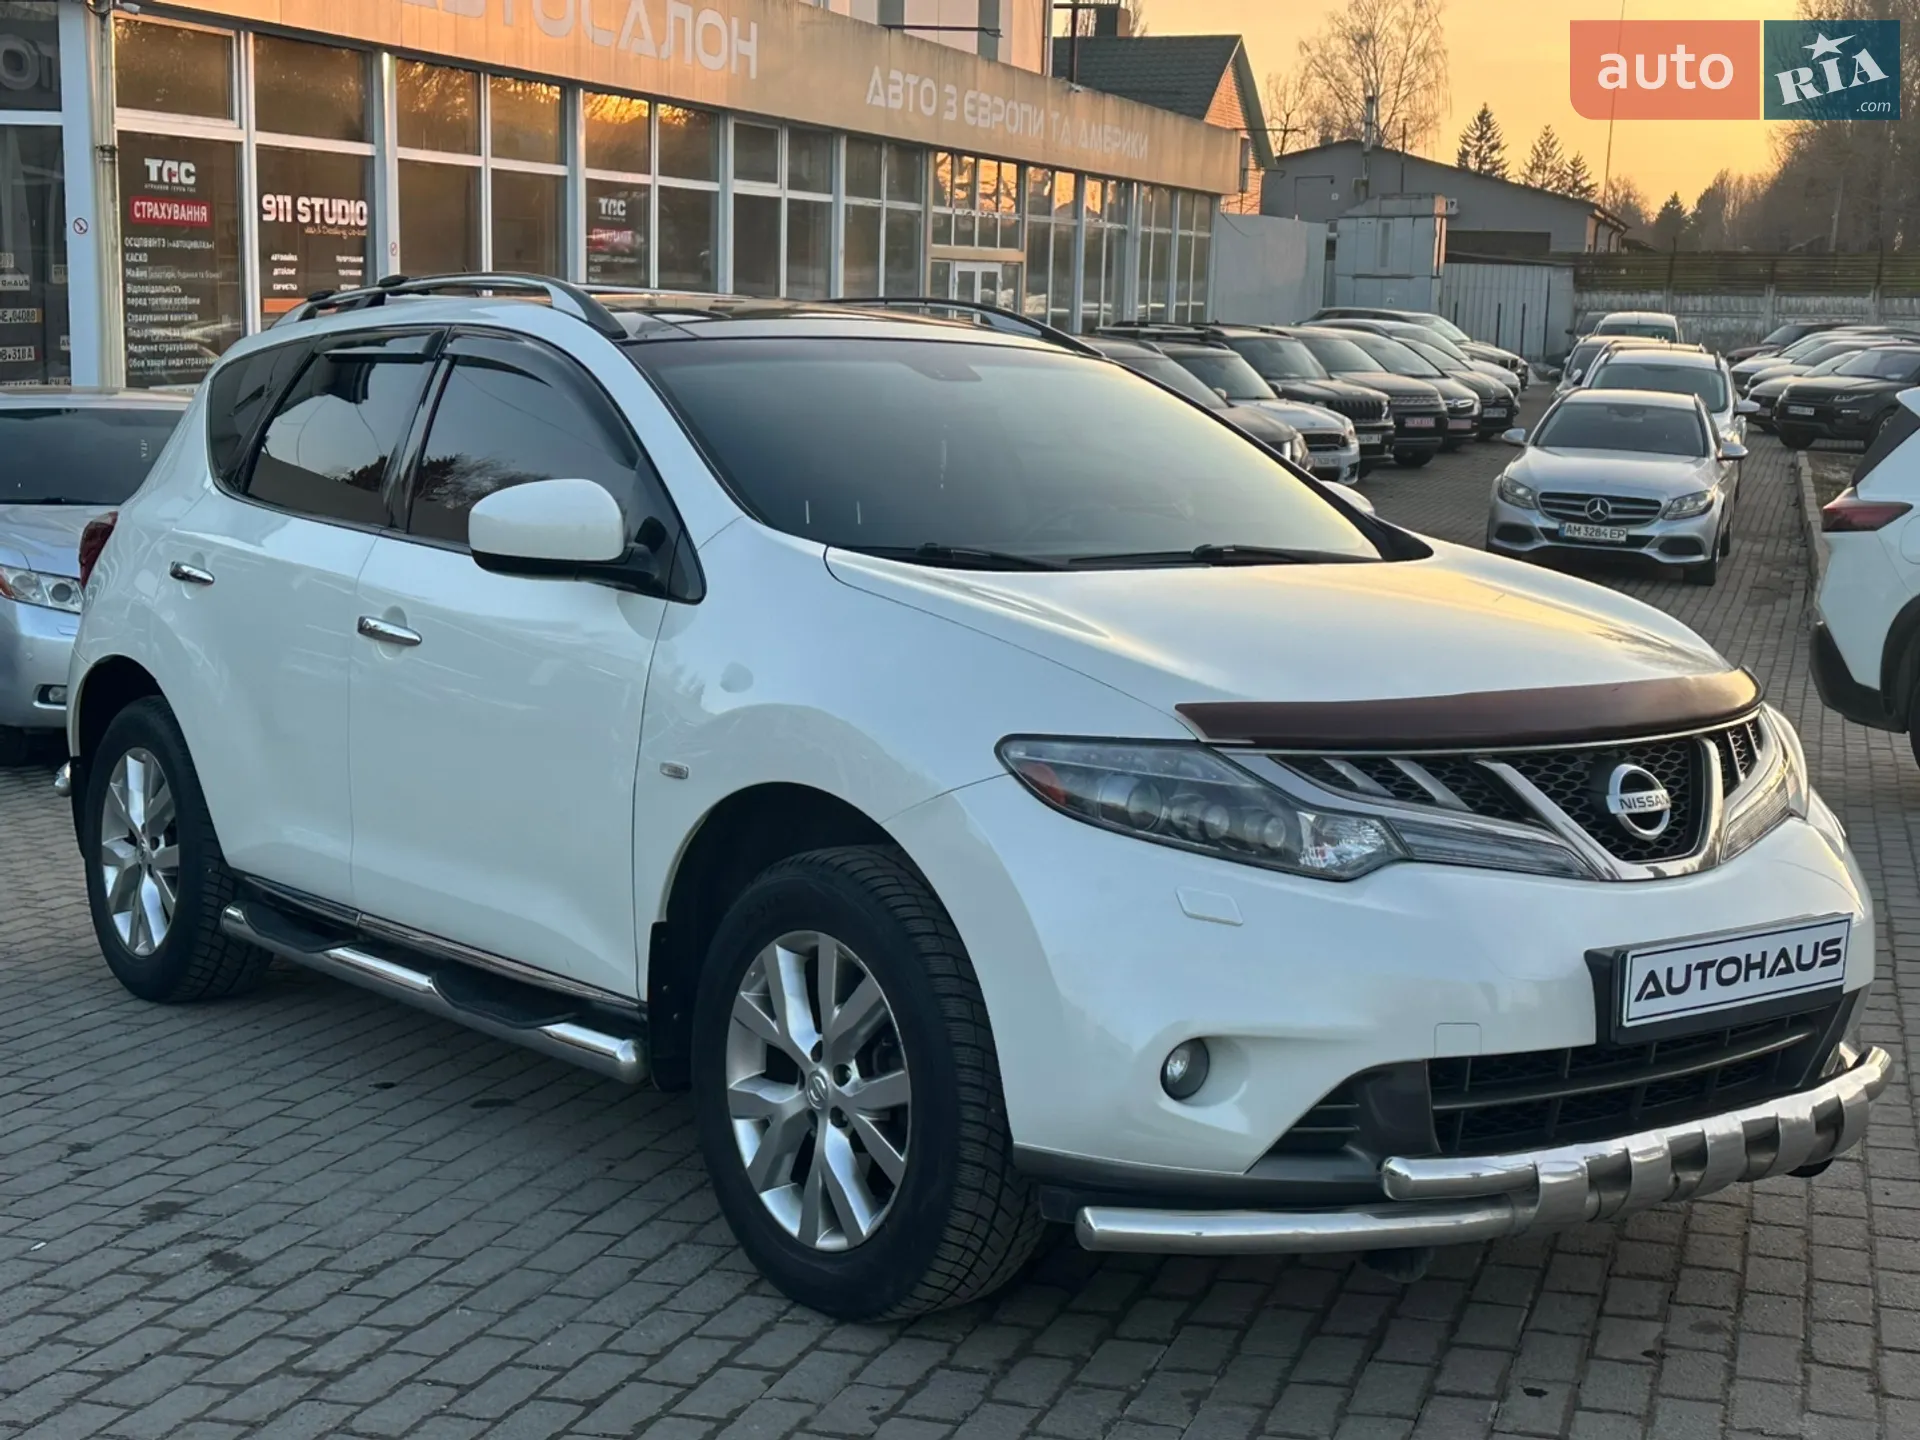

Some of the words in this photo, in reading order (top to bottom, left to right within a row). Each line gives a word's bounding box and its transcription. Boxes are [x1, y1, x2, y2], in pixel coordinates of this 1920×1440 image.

[396, 0, 758, 79] ОСАЛОН
[866, 65, 938, 117] АВТО
[943, 84, 958, 121] З
[963, 90, 1045, 139] ЄВРОПИ
[1051, 110, 1072, 146] ТА
[1078, 119, 1149, 160] АМЕРИКИ
[133, 201, 208, 223] СТРАХУВАННЯ
[262, 194, 292, 222] 911
[297, 196, 368, 226] STUDIO
[1619, 793, 1670, 810] NISSAN
[1634, 936, 1844, 1003] AUTOHAUS
